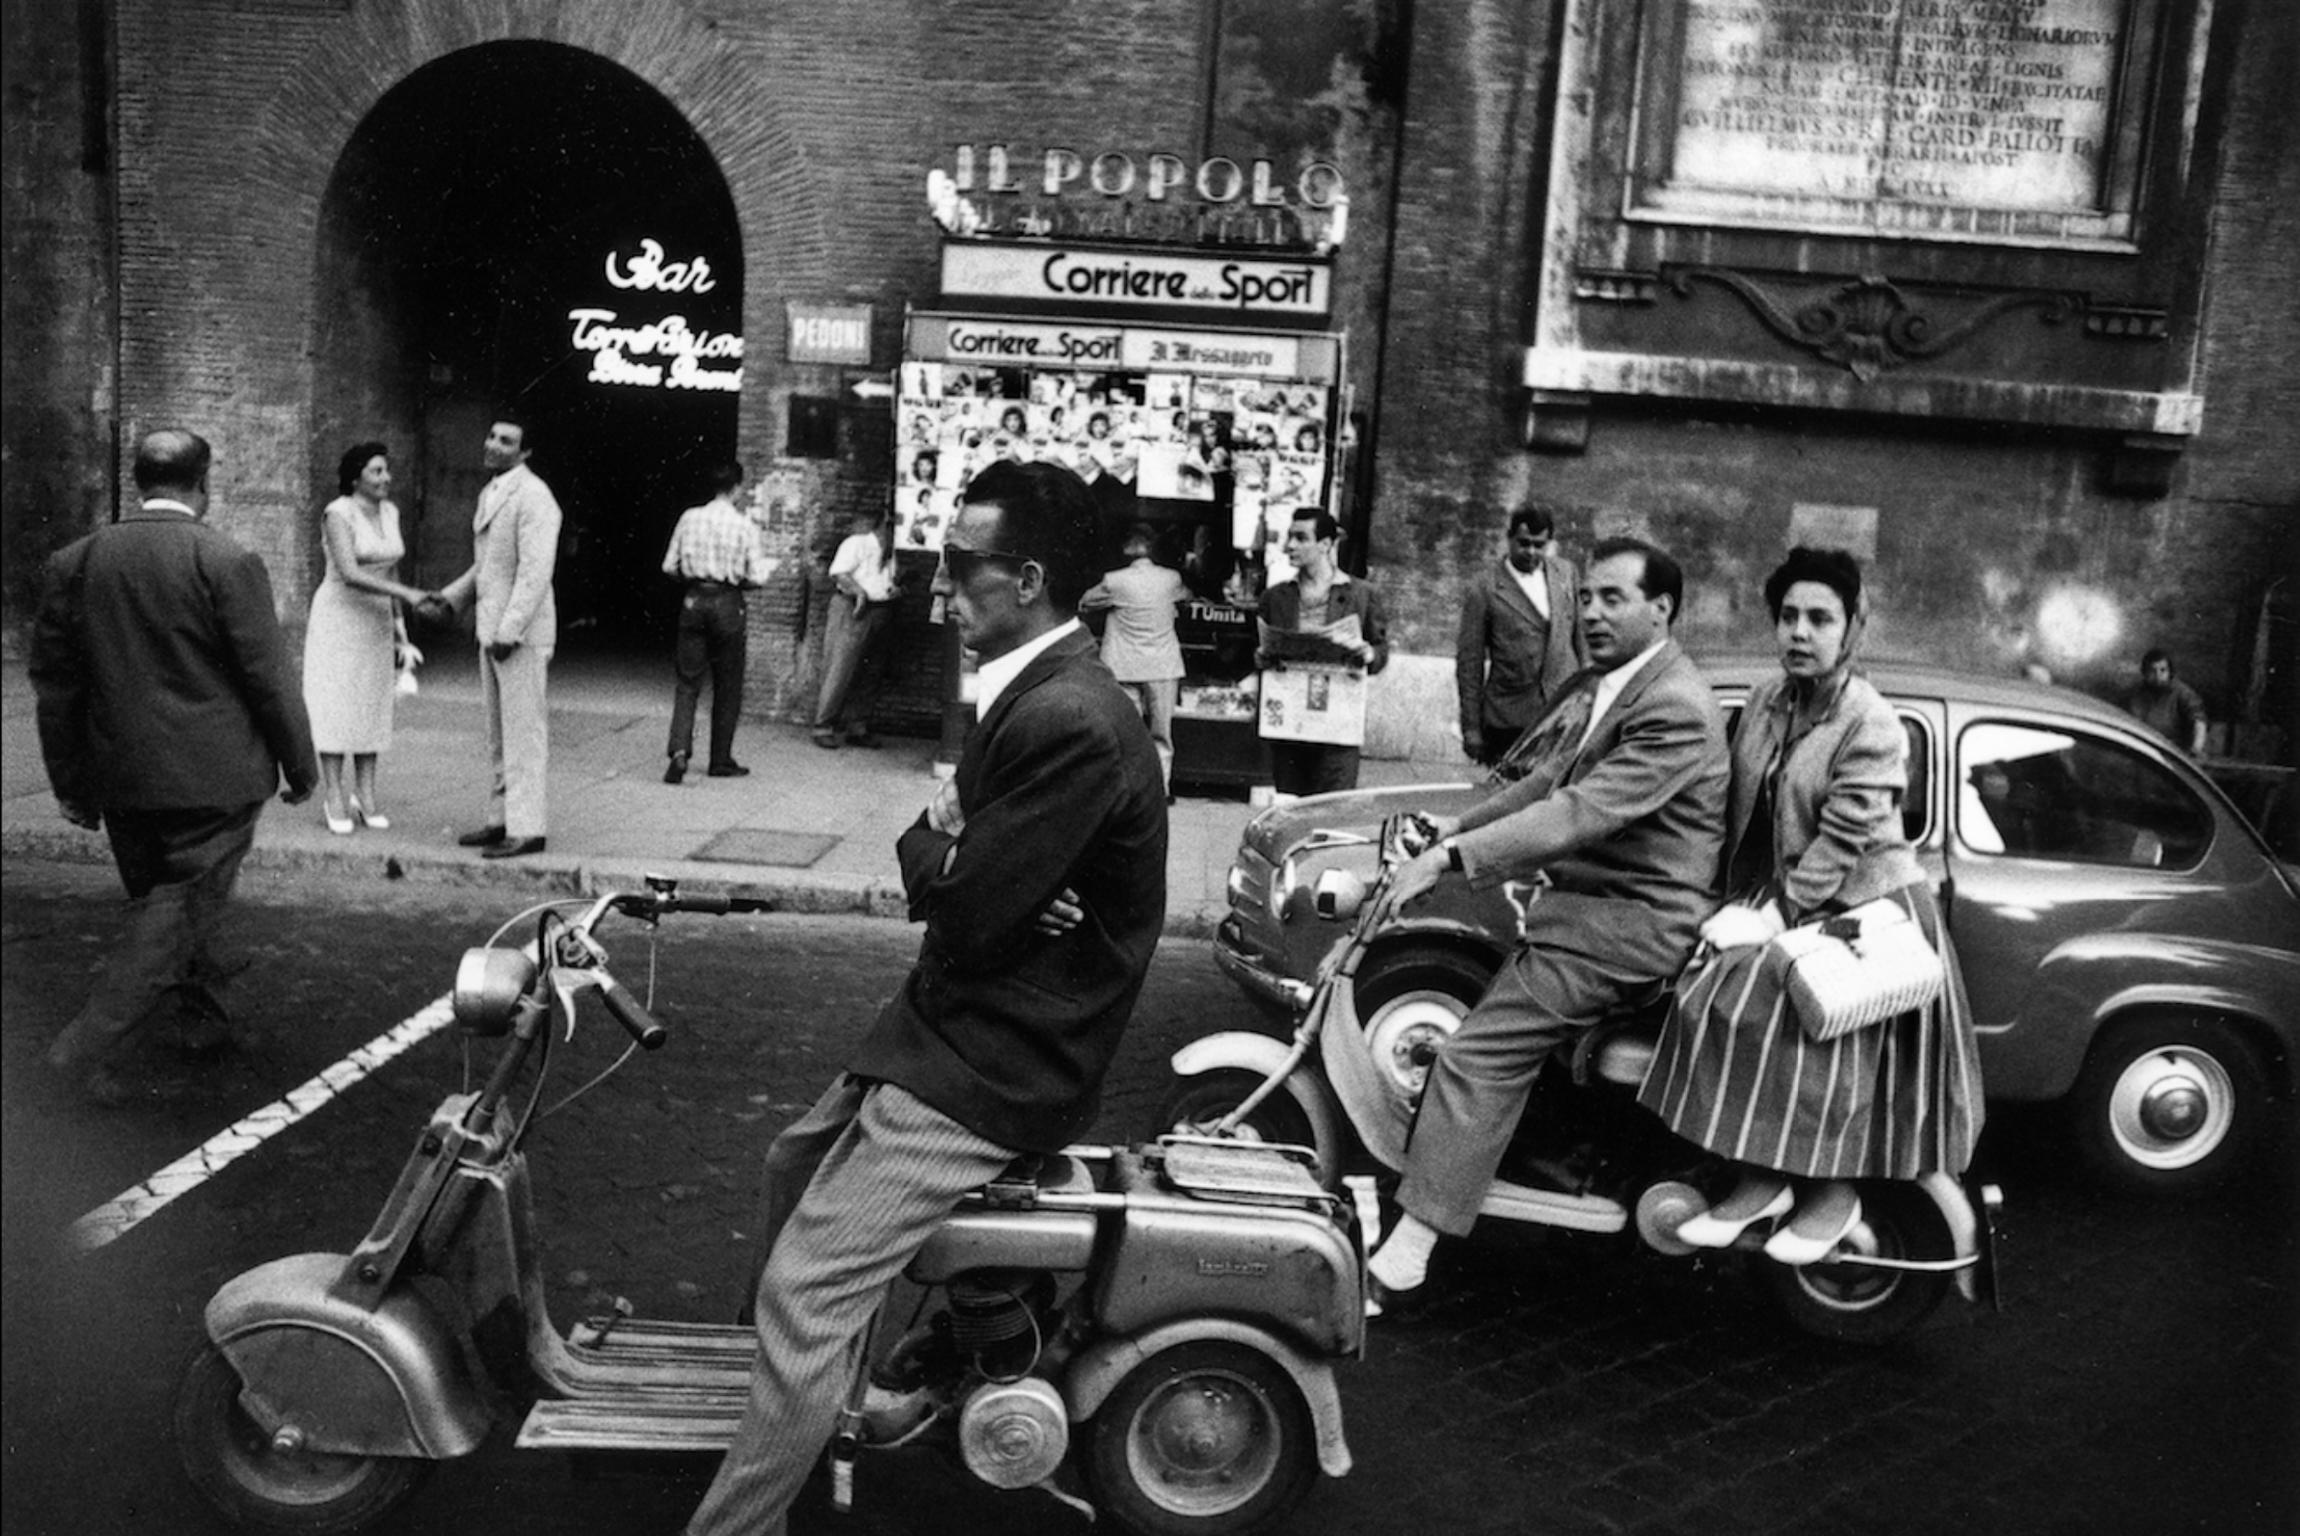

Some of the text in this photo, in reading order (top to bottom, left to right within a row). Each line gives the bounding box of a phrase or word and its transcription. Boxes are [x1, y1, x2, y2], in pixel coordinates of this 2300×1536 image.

[2004, 59, 2065, 80] LIGNIS
[1907, 124, 1977, 147] CARD
[2007, 113, 2064, 134] IVSSIT
[957, 143, 1345, 208] IL POPOLO
[605, 238, 716, 293] Bar
[1043, 252, 1187, 299] Corriere
[1219, 264, 1314, 308] Sport
[793, 318, 866, 349] PEDONI
[949, 328, 1122, 365] Corriere Sport
